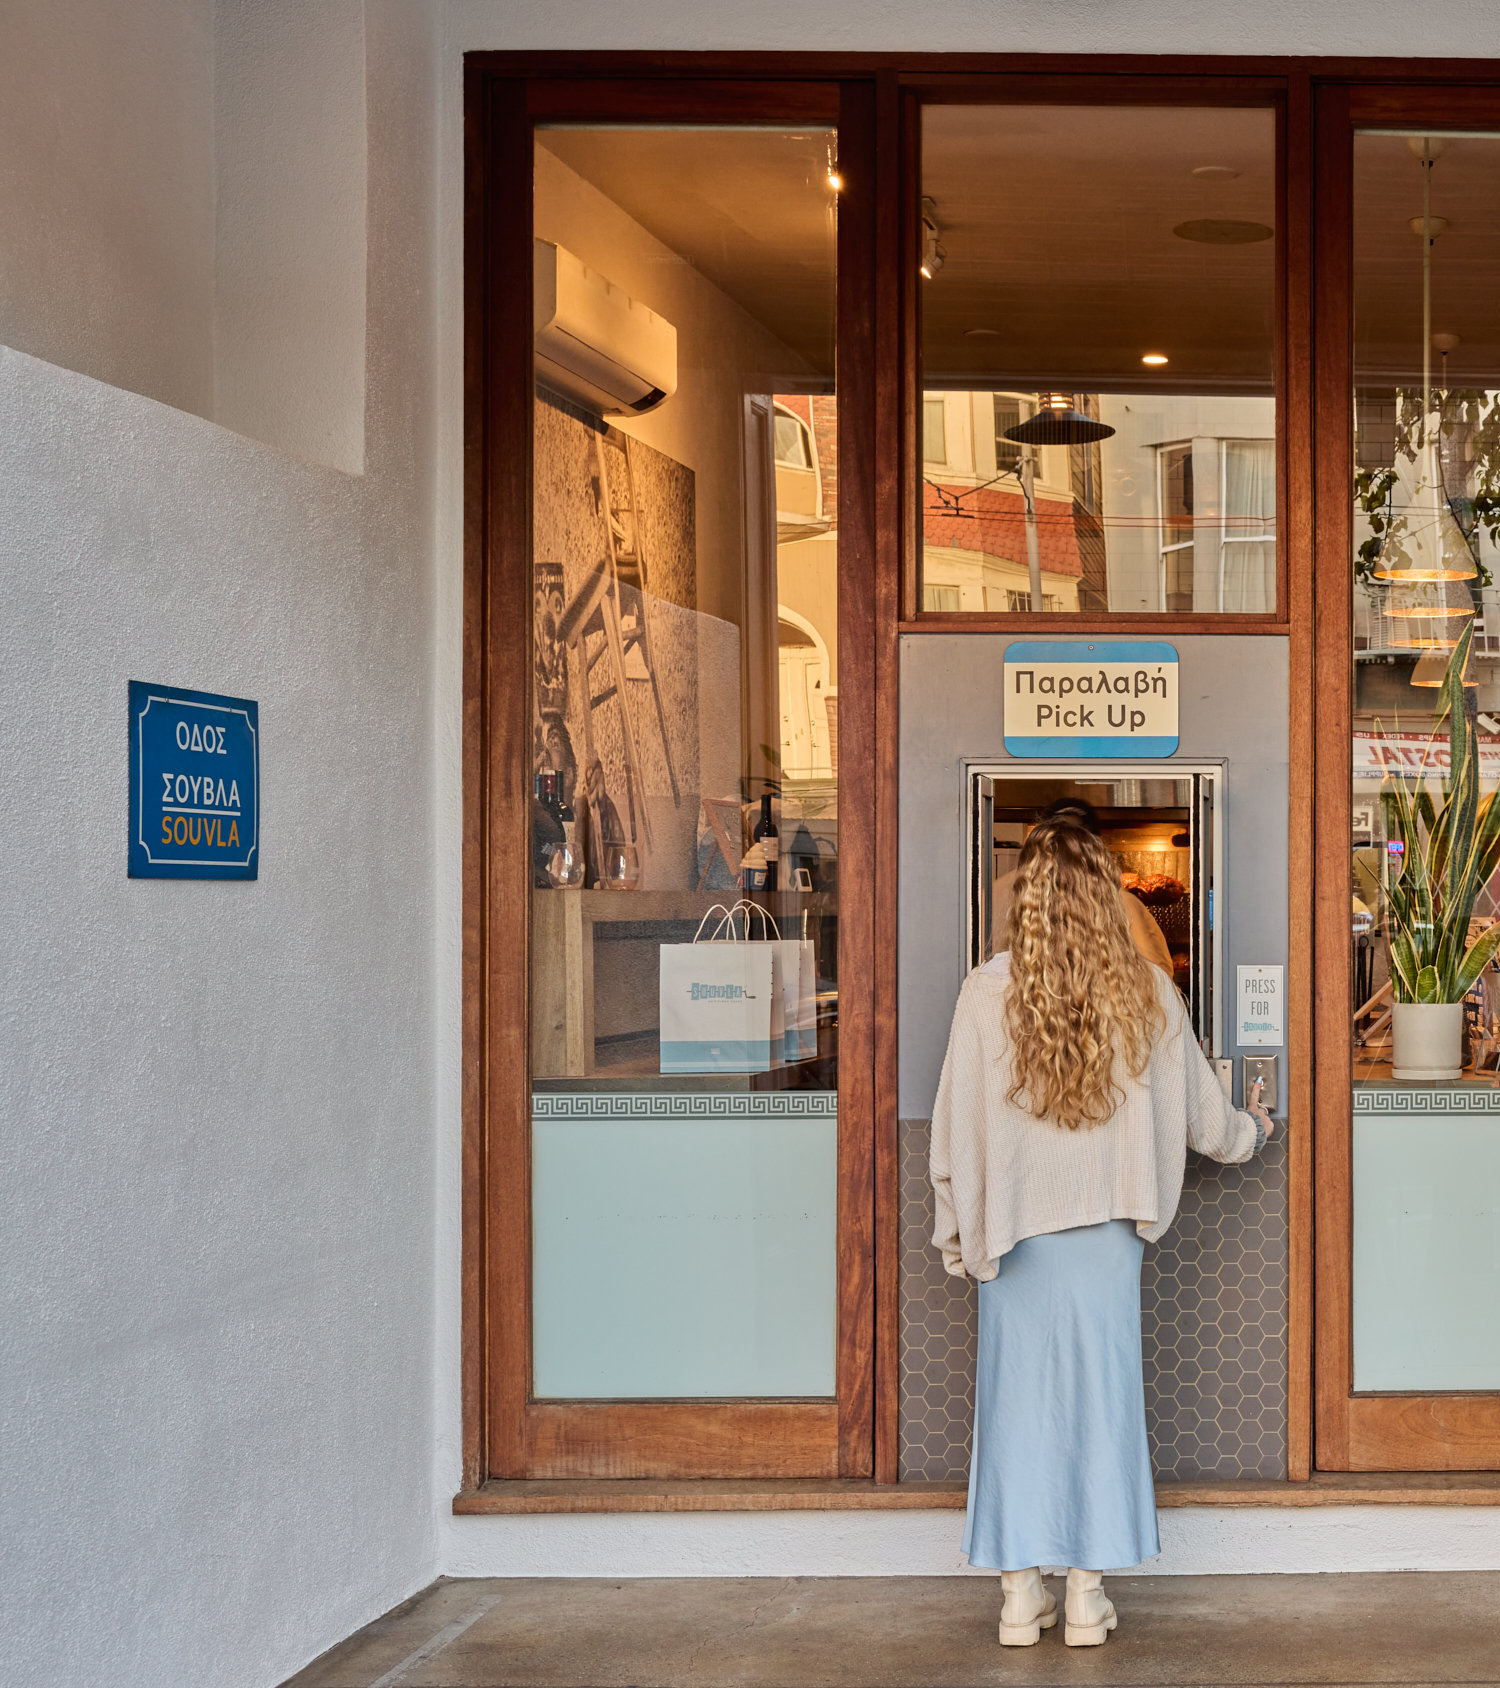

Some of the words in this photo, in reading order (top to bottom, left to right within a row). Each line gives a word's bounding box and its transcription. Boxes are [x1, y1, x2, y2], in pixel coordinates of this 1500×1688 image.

[1015, 667, 1167, 698] Παραλαβή
[1036, 704, 1095, 728] Pick
[1107, 704, 1146, 732] Up
[175, 721, 227, 754] ΟΔΟΣ
[162, 773, 241, 808] ΣΟΥΒΛΑ
[161, 816, 240, 847] SOUVLA
[692, 983, 743, 999] SOUVLA
[1245, 979, 1276, 994] PRESS
[1251, 1001, 1269, 1016] FOR
